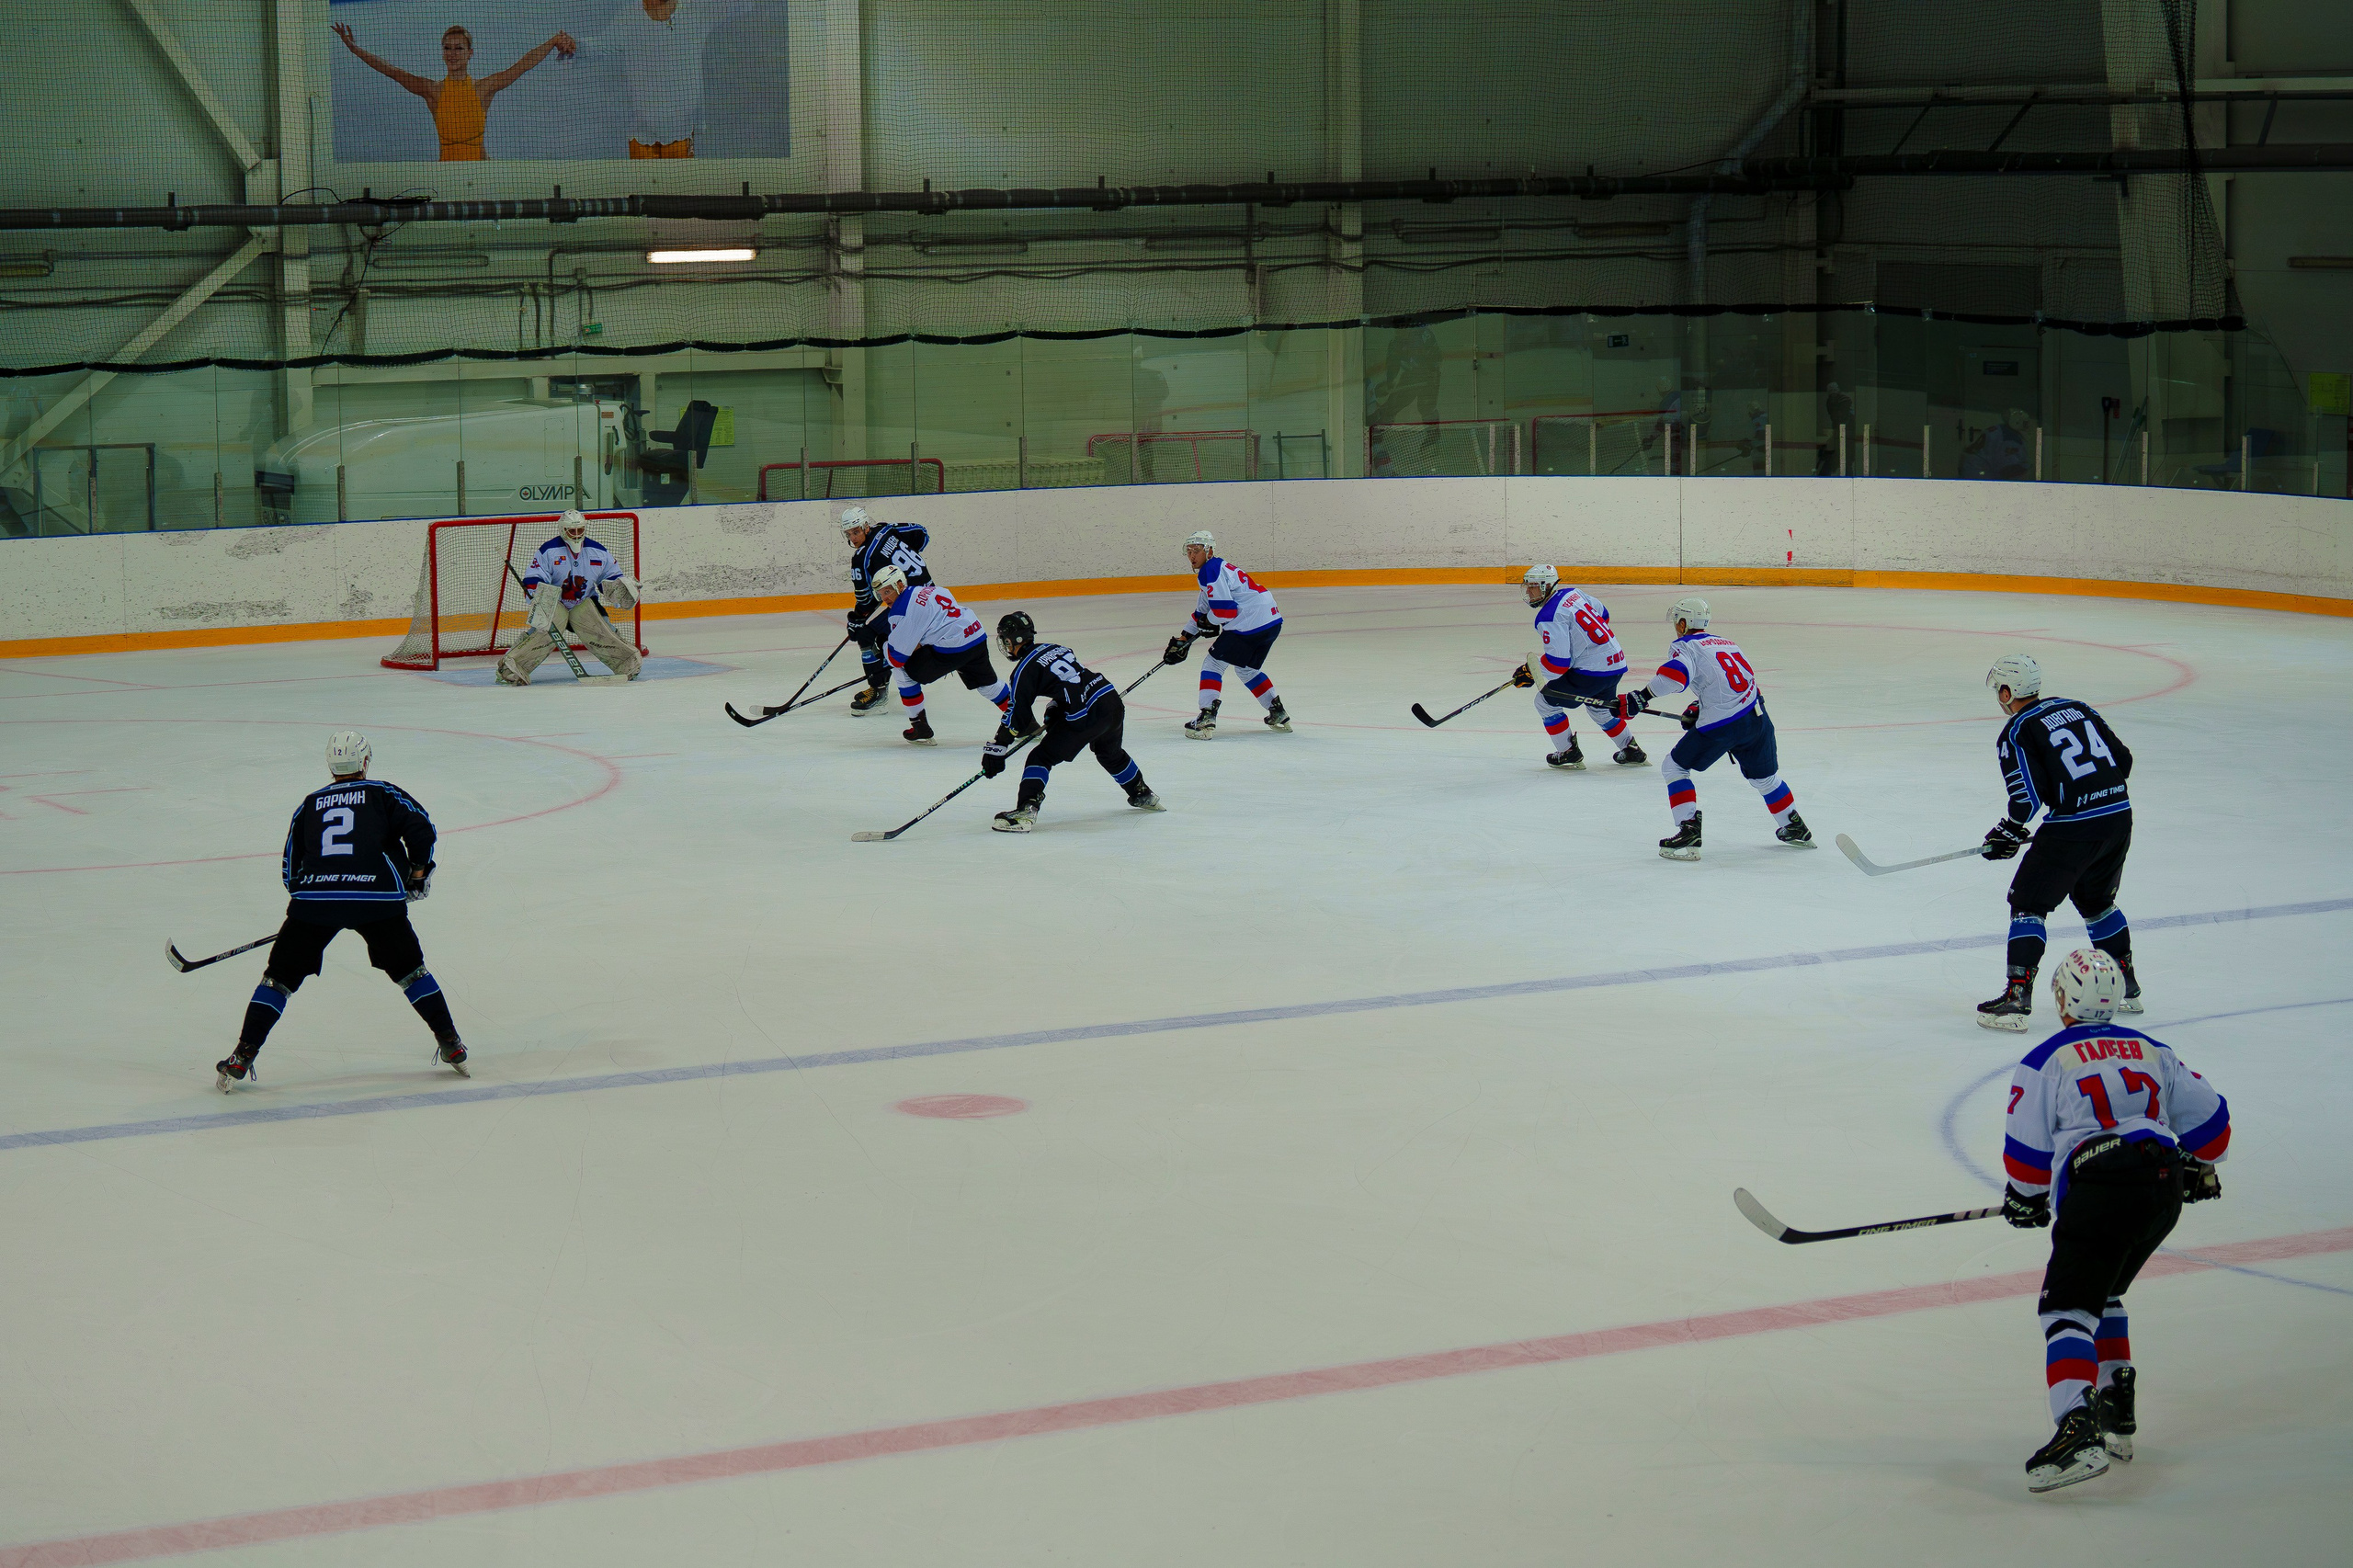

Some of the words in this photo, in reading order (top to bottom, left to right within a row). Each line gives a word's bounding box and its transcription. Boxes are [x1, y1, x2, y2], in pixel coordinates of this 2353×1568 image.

[519, 485, 592, 501] OLYMPA
[892, 540, 926, 577] 96
[1207, 585, 1214, 598] 2
[934, 594, 962, 619] 8
[1574, 602, 1615, 646] 86
[551, 631, 585, 676] BAUER
[1716, 651, 1755, 694] 81
[1574, 695, 1605, 706] CCM
[2040, 707, 2086, 732] ДОВГАЛЬ
[337, 748, 343, 756] 2
[2048, 720, 2117, 781] 24
[315, 790, 366, 812] БАРМИН
[2089, 789, 2109, 801] ONE
[321, 806, 355, 857] 2
[1995, 824, 2022, 844] CCM
[314, 874, 340, 882] ONE
[341, 874, 377, 882] TIMER
[2094, 1009, 2106, 1018] 17
[2073, 1039, 2144, 1063] ГАЛЕЕВ
[2075, 1065, 2162, 1131] 17
[2074, 1137, 2122, 1168] BAUER
[1859, 1225, 1892, 1236] ONE
[1893, 1219, 1938, 1232] TIMER
